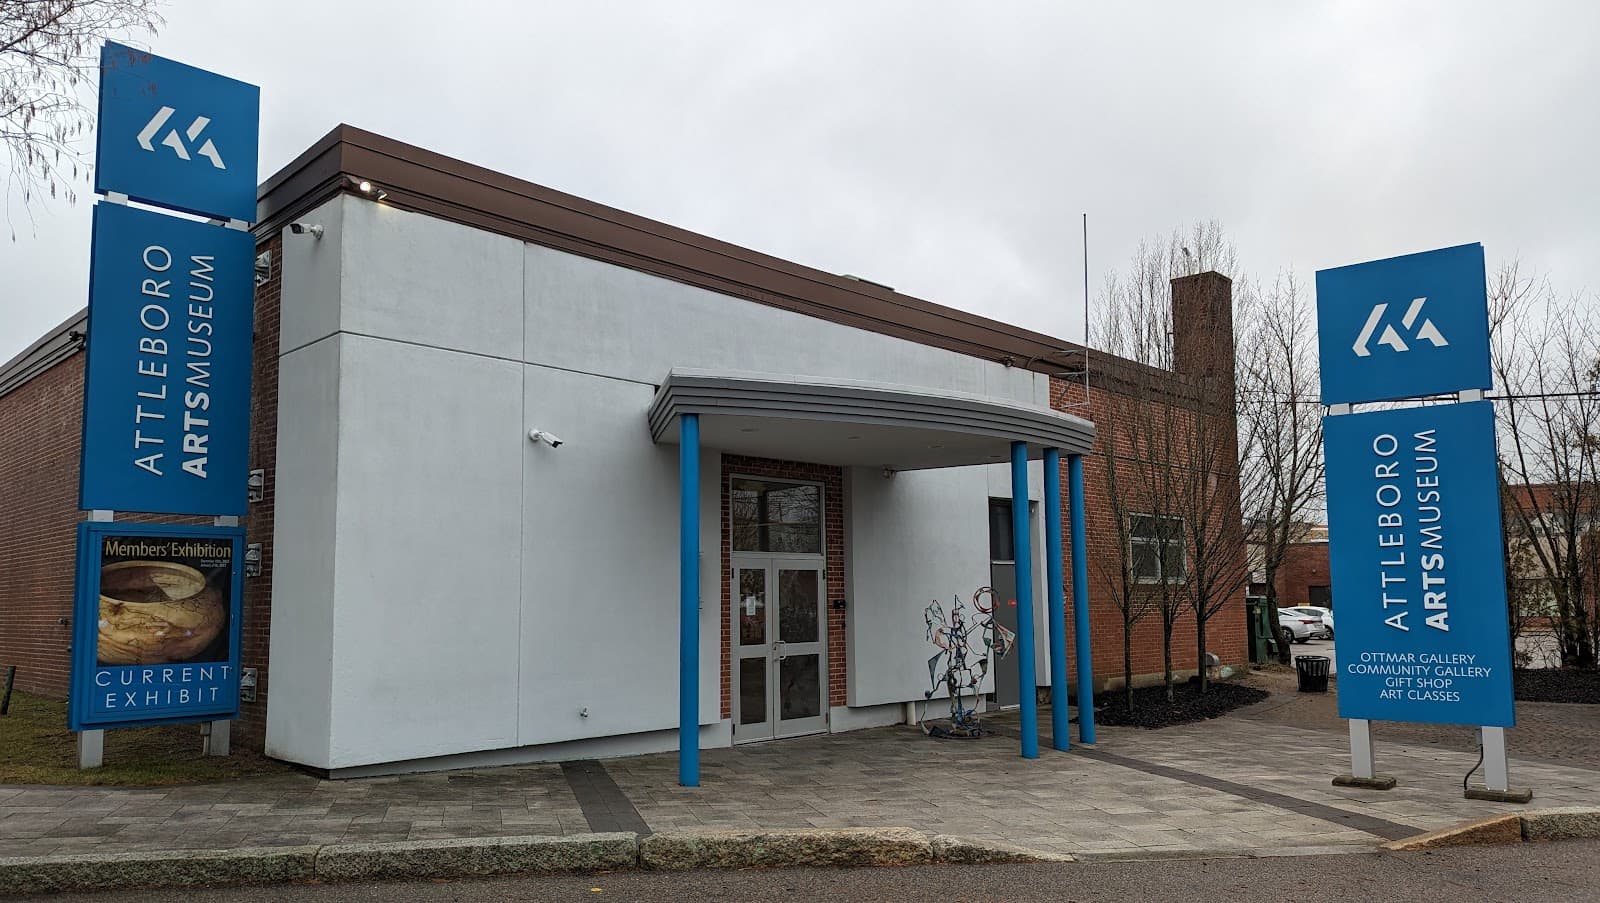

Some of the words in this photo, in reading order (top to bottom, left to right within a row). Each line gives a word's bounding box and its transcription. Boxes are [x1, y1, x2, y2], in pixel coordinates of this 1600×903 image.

[134, 245, 172, 476] ATTLEBORO
[1373, 433, 1410, 632] ATTLEBORO
[105, 541, 171, 558] Members'
[171, 542, 231, 559] Exhibition
[1360, 652, 1416, 663] OTTMAR
[1419, 653, 1476, 665] GALLERY
[95, 665, 231, 687] CURRENT
[1347, 663, 1431, 676] COMMUNITY
[1434, 666, 1492, 678] GALLERY
[1385, 677, 1413, 688] GIFT
[1416, 678, 1453, 689] SHOP
[105, 687, 219, 708] EXHIBIT
[1379, 689, 1403, 700] ART
[1407, 690, 1460, 702] CLASSES
